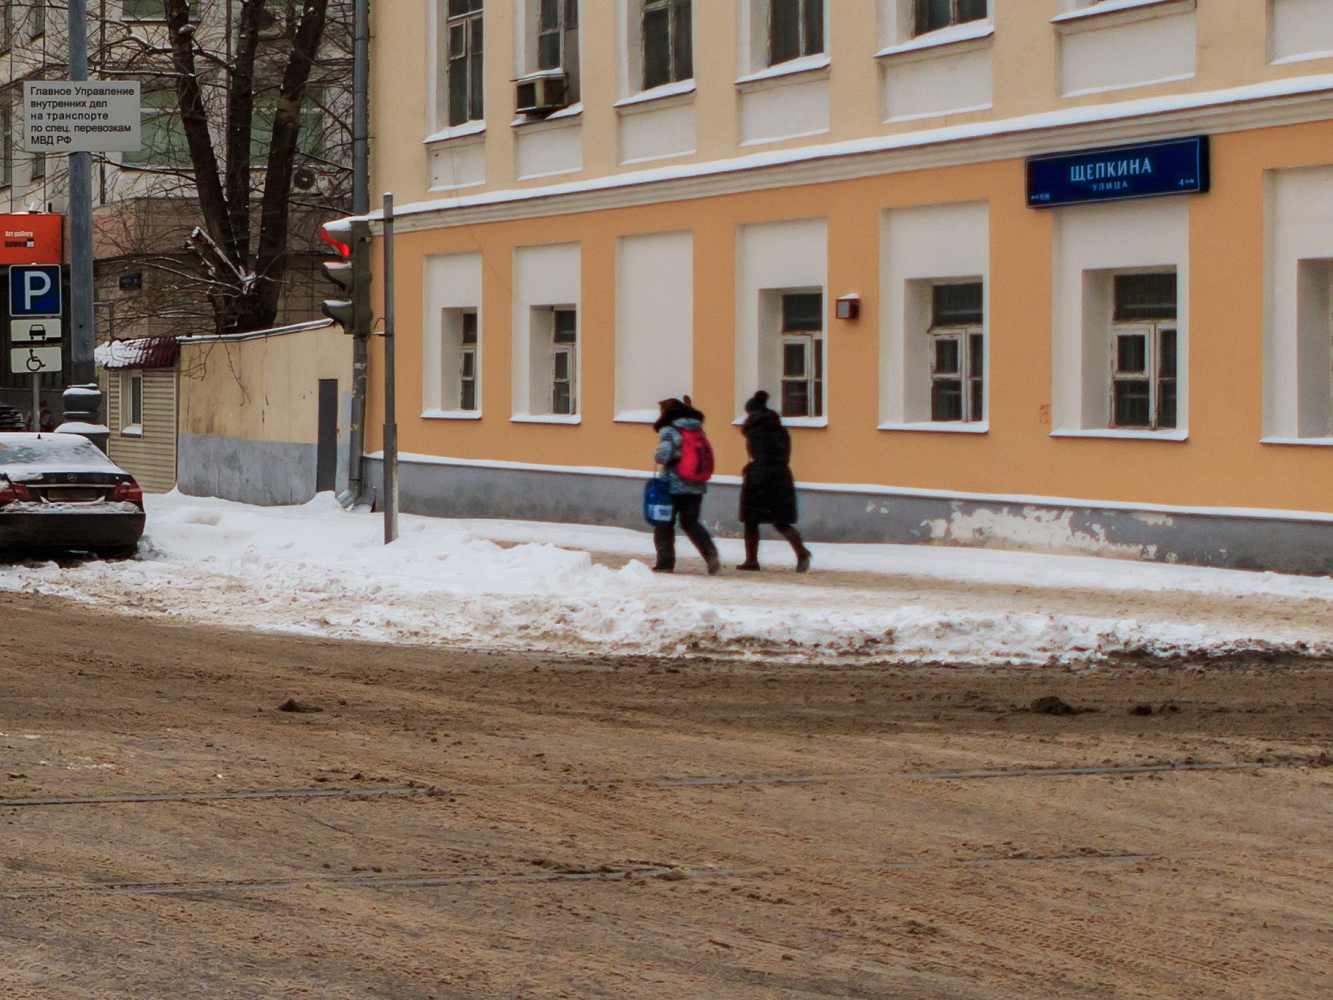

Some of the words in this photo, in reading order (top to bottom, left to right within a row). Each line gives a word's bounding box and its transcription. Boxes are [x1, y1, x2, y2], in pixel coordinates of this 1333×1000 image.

[30, 86, 72, 96] Главное
[74, 86, 135, 97] Управление
[30, 100, 87, 109] внутренних
[89, 100, 108, 109] дел
[47, 112, 108, 122] транспорте
[45, 125, 71, 134] спец.
[74, 125, 132, 134] перевозкам
[30, 136, 54, 146] МВД
[56, 136, 72, 144] РФ
[1070, 157, 1152, 182] ЩЕПКИНА
[1092, 181, 1128, 192] УЛИЦА
